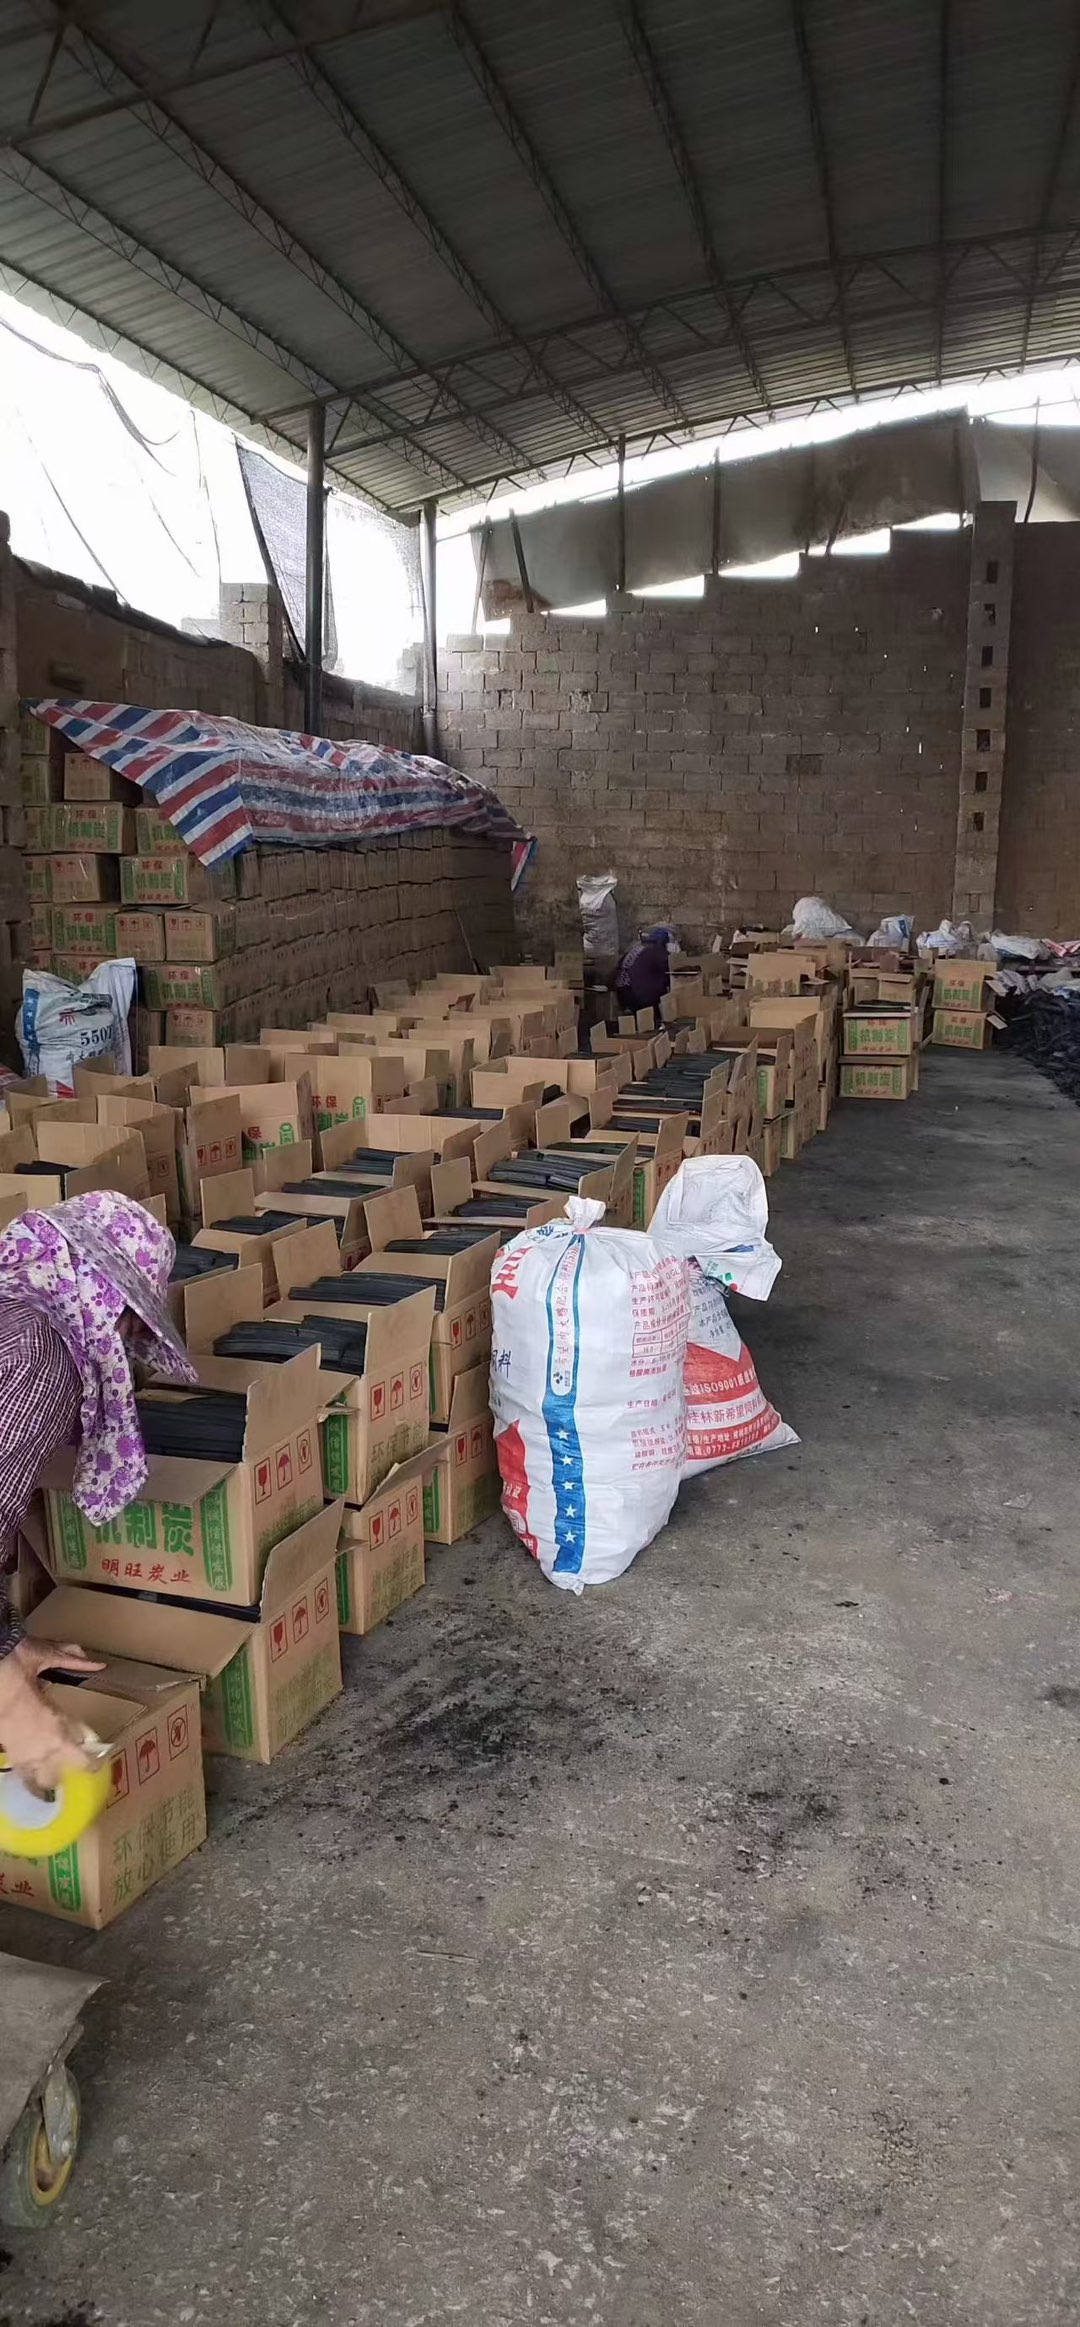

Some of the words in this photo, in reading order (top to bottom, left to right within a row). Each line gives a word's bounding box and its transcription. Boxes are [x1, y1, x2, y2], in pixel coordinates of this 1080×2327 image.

[80, 1023, 113, 1046] 5507
[311, 1095, 338, 1108] 环保
[627, 1399, 658, 1409] 生产日期
[101, 1558, 191, 1584] 明旺炭业
[112, 1781, 197, 1866] 环保节能
[113, 1814, 199, 1907] 放心使用
